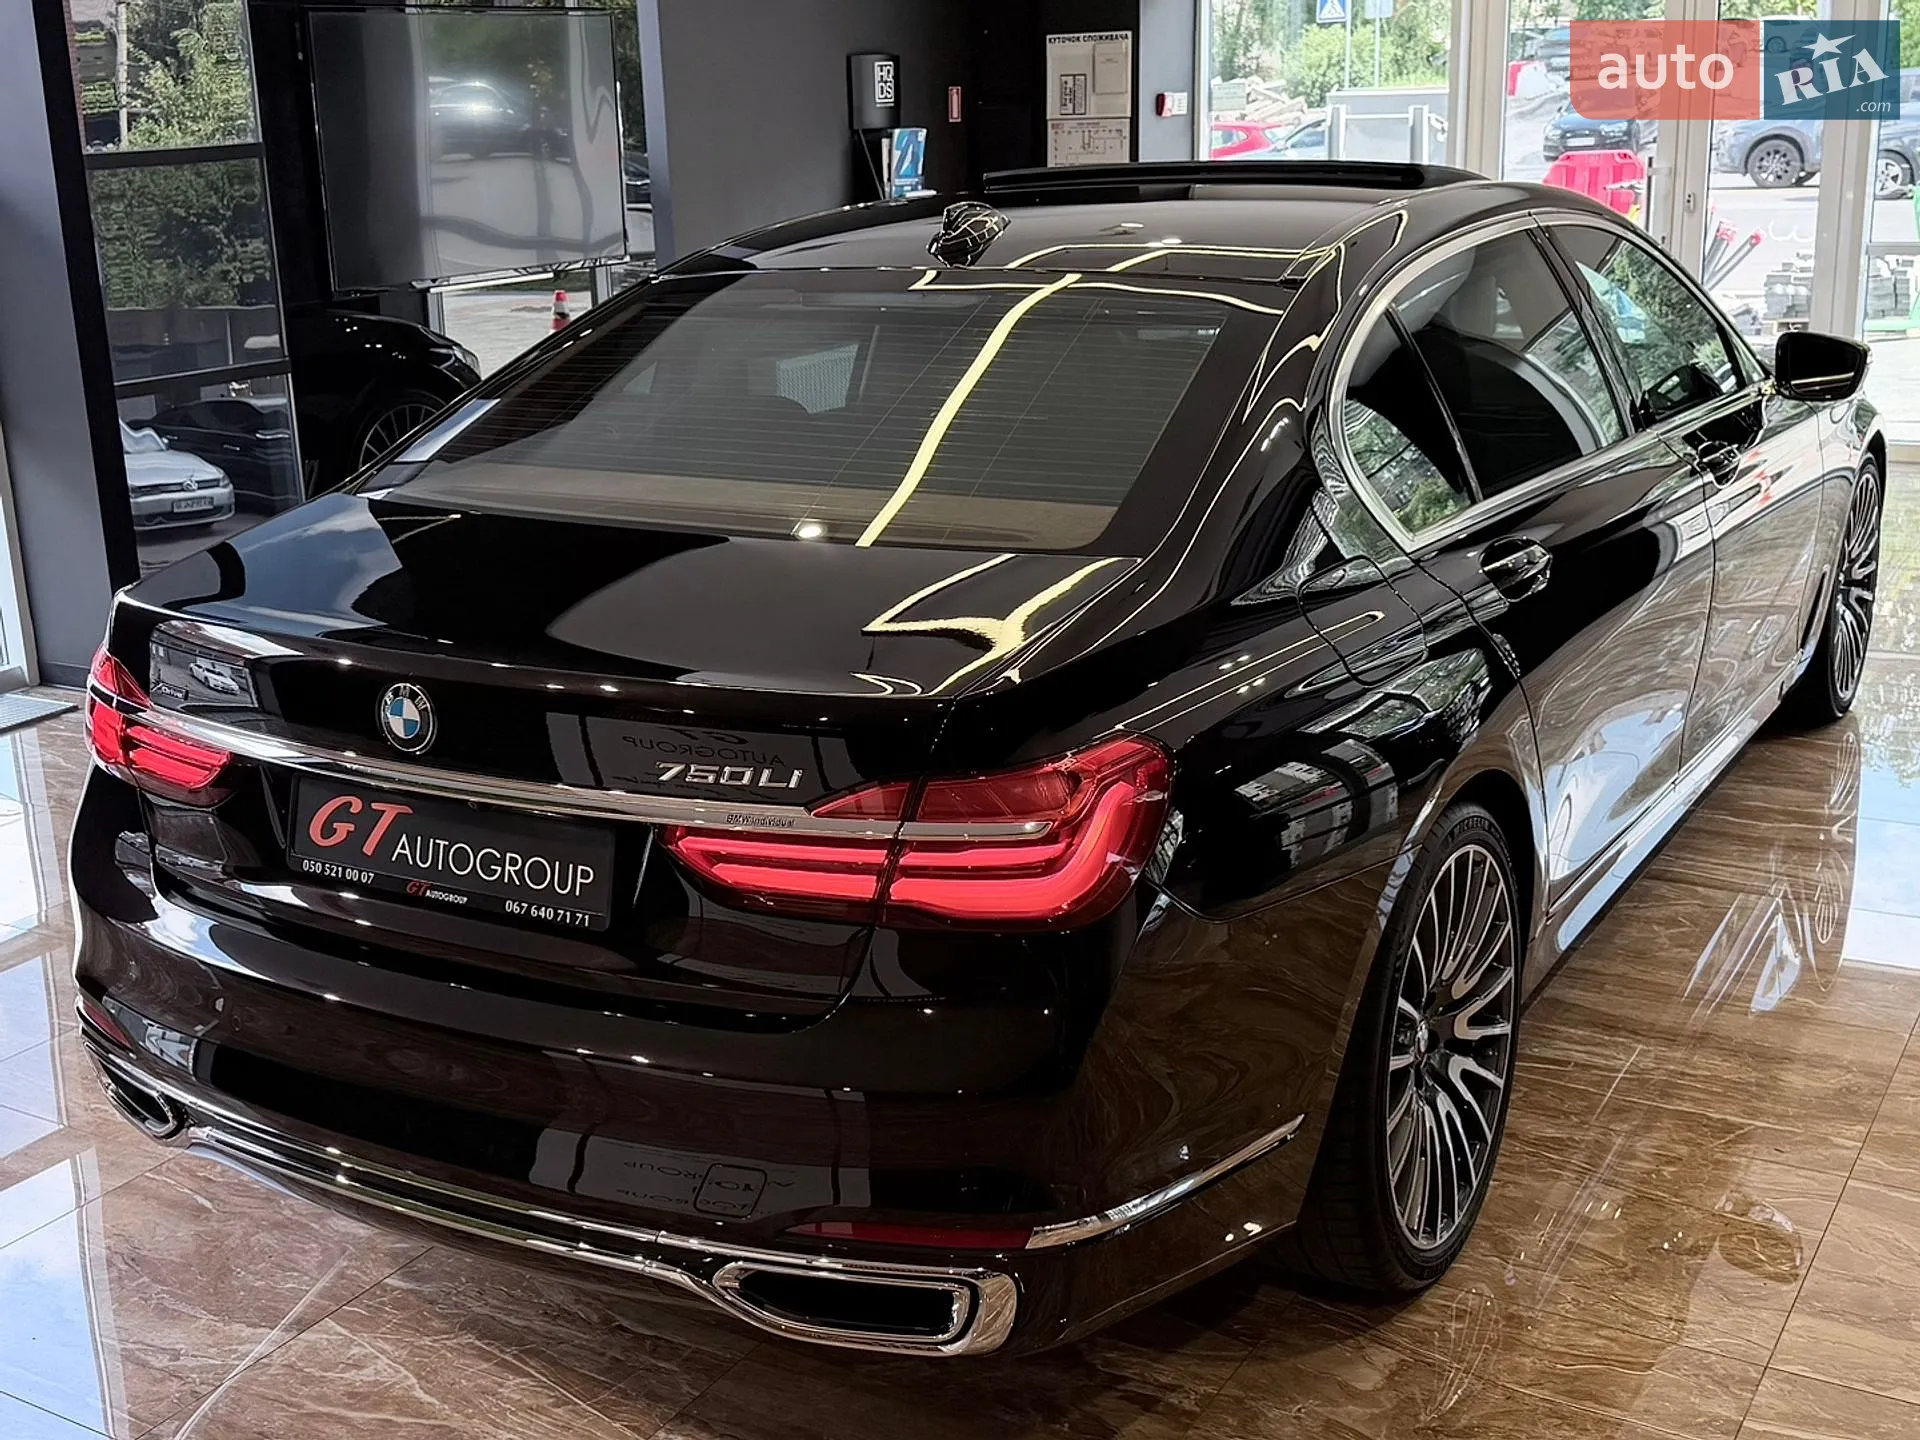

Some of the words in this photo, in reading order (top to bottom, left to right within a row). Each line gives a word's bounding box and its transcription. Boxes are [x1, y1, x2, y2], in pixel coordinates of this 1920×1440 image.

[384, 684, 427, 711] BMW
[309, 795, 414, 857] GT
[391, 833, 595, 896] AUTOGROUP
[302, 859, 322, 874] 050
[323, 863, 343, 878] 521
[345, 867, 359, 881] 00
[360, 870, 375, 884] 07
[406, 880, 431, 896] GT
[425, 889, 468, 904] AUTOGROUP
[505, 900, 528, 915] 067
[530, 904, 554, 920] 640
[556, 908, 571, 924] 71
[574, 911, 591, 928] 71
